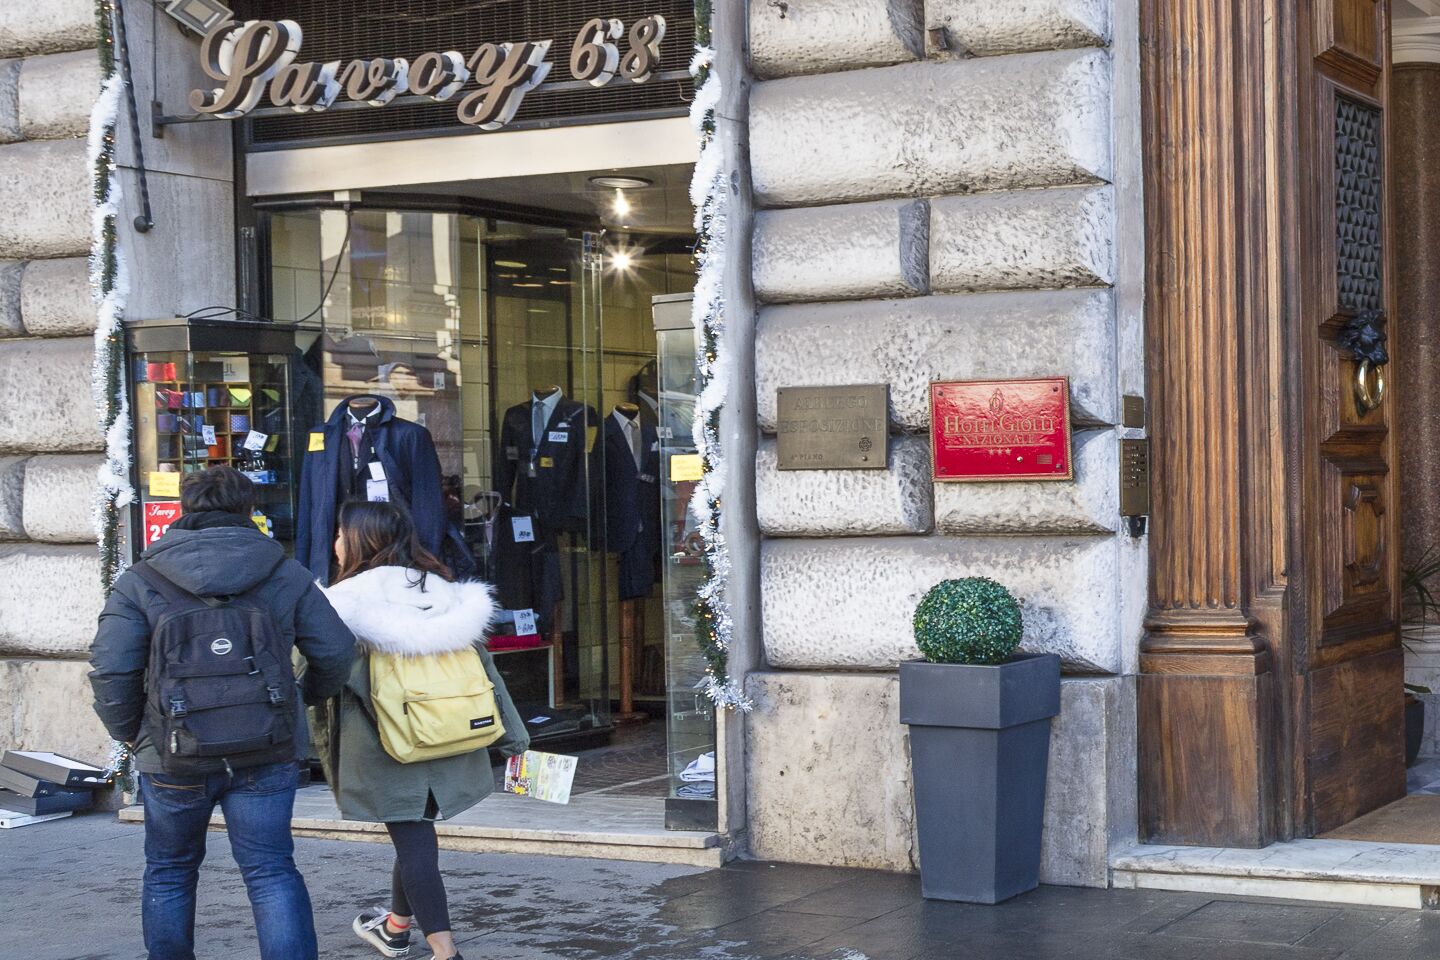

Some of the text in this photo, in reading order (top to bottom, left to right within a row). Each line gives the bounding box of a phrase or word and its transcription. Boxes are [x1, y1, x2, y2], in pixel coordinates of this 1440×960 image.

[188, 14, 666, 131] Savoy 68
[944, 413, 1055, 434] HOTEL GIOLLI
[963, 434, 1036, 445] NAZIONALE
